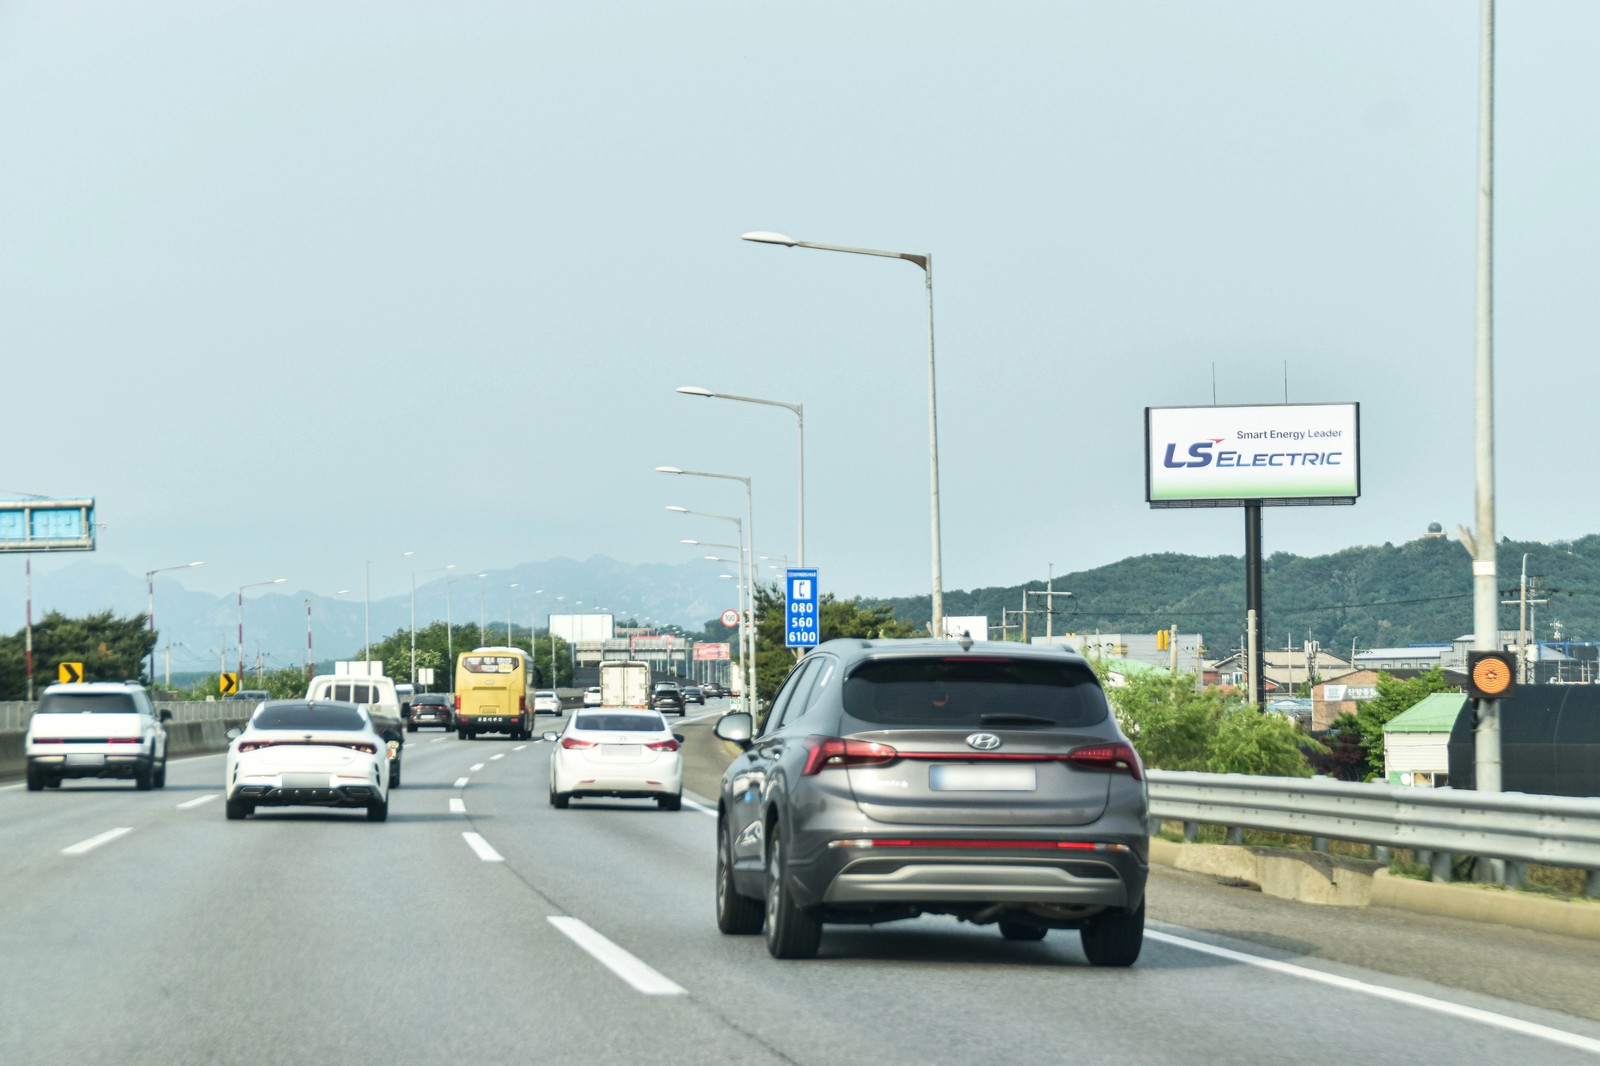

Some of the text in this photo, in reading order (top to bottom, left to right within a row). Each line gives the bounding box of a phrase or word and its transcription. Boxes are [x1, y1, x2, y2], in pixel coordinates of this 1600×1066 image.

[1237, 429, 1342, 441] Smart Energy Leader
[1163, 442, 1342, 468] LS ELECTRIC
[791, 602, 813, 613] 080
[725, 614, 736, 622] 100
[791, 617, 813, 628] 560
[789, 631, 816, 642] 6100
